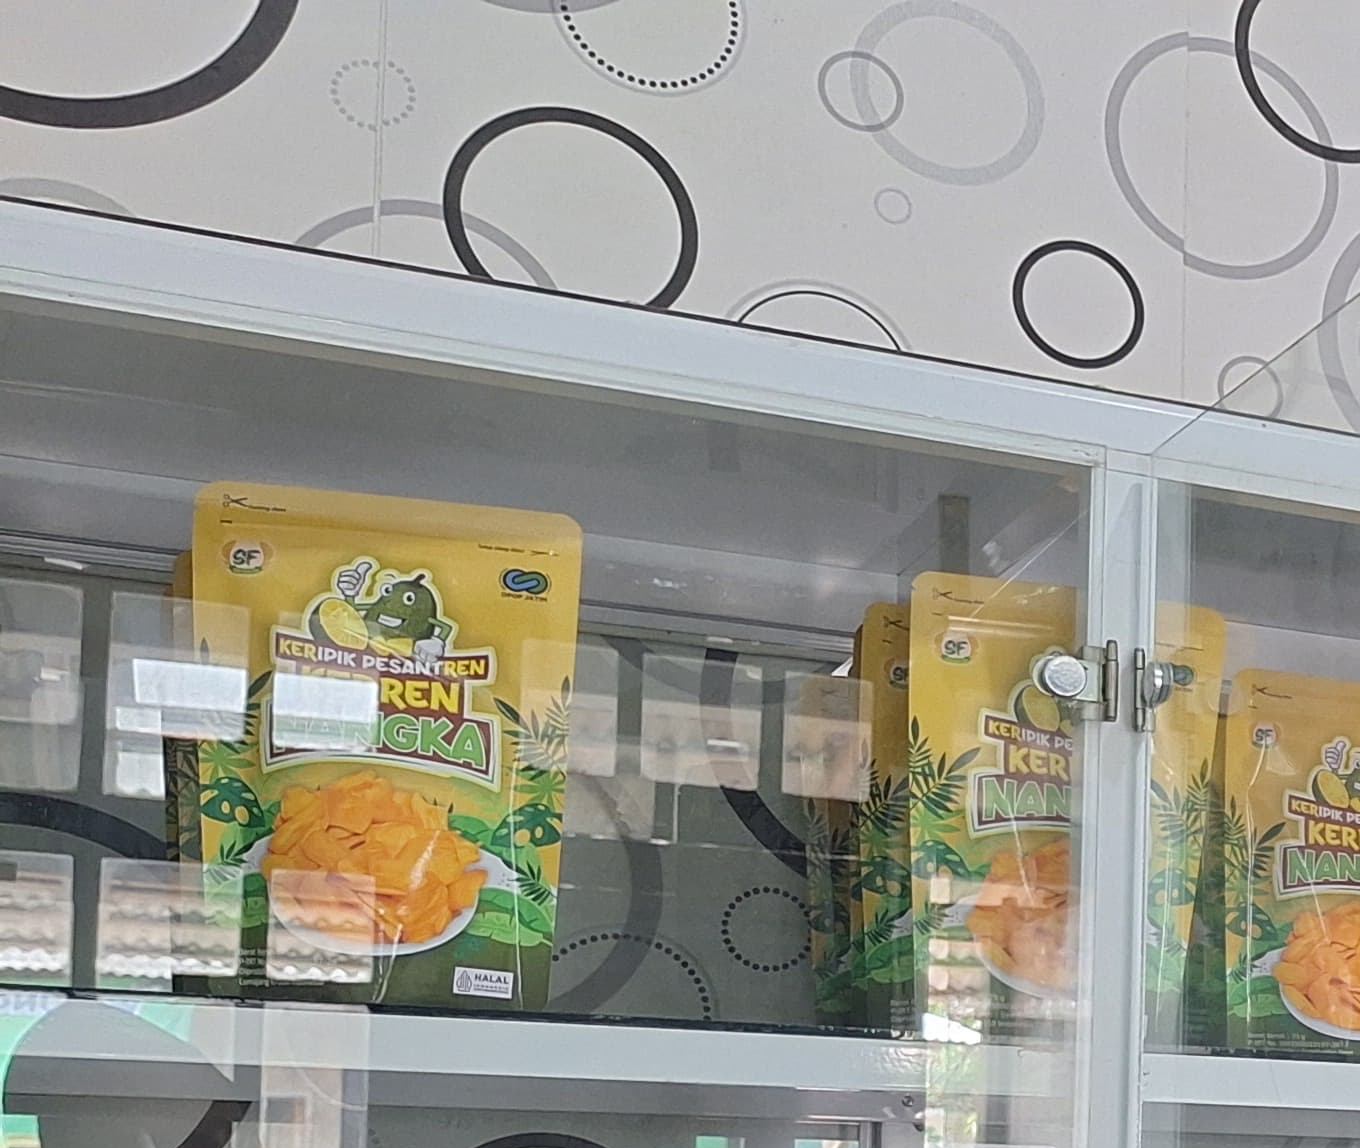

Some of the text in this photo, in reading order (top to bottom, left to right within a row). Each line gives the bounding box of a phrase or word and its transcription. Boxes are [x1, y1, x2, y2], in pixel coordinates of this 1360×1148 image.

[233, 549, 260, 566] SF
[279, 638, 485, 678] KERIPIK PESANTREN
[944, 639, 969, 656] SF
[282, 713, 487, 767] NGKA
[988, 719, 1051, 747] KERIPIK
[1009, 744, 1072, 782] KER
[981, 776, 1074, 822] NAN
[1291, 798, 1344, 822] KERIPIK
[474, 974, 510, 985] HALAL
